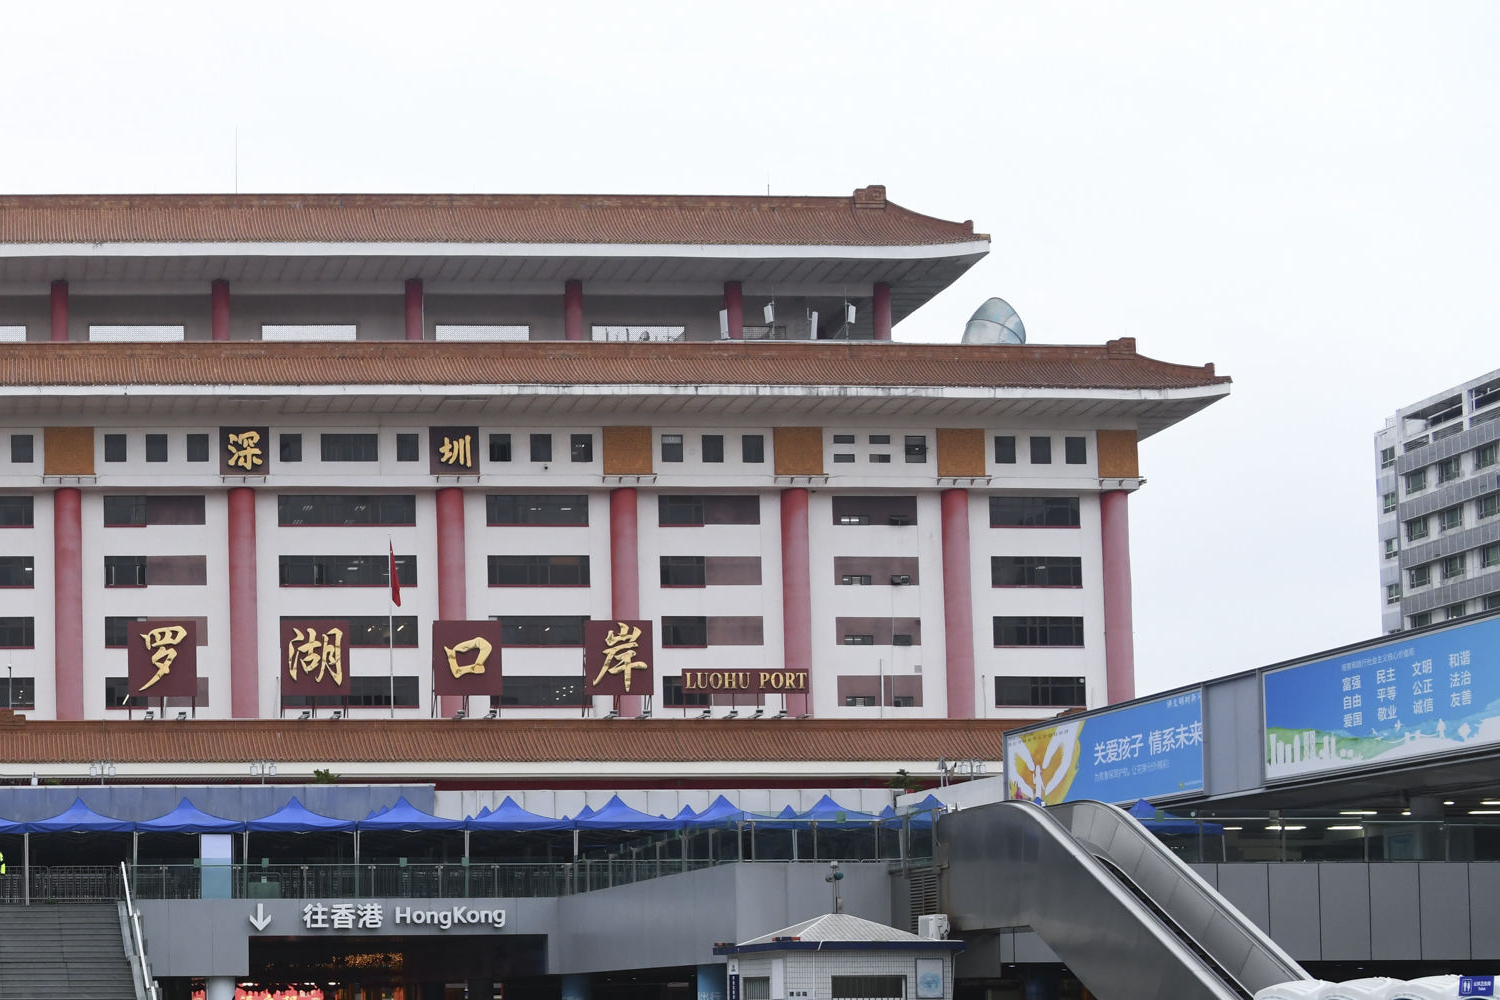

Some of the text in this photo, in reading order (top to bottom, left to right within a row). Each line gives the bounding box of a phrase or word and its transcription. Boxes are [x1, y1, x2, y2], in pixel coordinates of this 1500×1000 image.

[139, 621, 648, 693] 罗湖口岸
[1342, 651, 1471, 692] 富强 民主 文明 和谐
[684, 672, 807, 690] LUOHU PORT
[1343, 671, 1472, 710] 自由 平等 公正 法治
[1343, 690, 1472, 728] 爱国 敬业 诚信 友善
[1094, 733, 1144, 766] 关爱孩子
[1149, 720, 1203, 756] 情系未来
[302, 903, 506, 930] 往香港 HongKong
